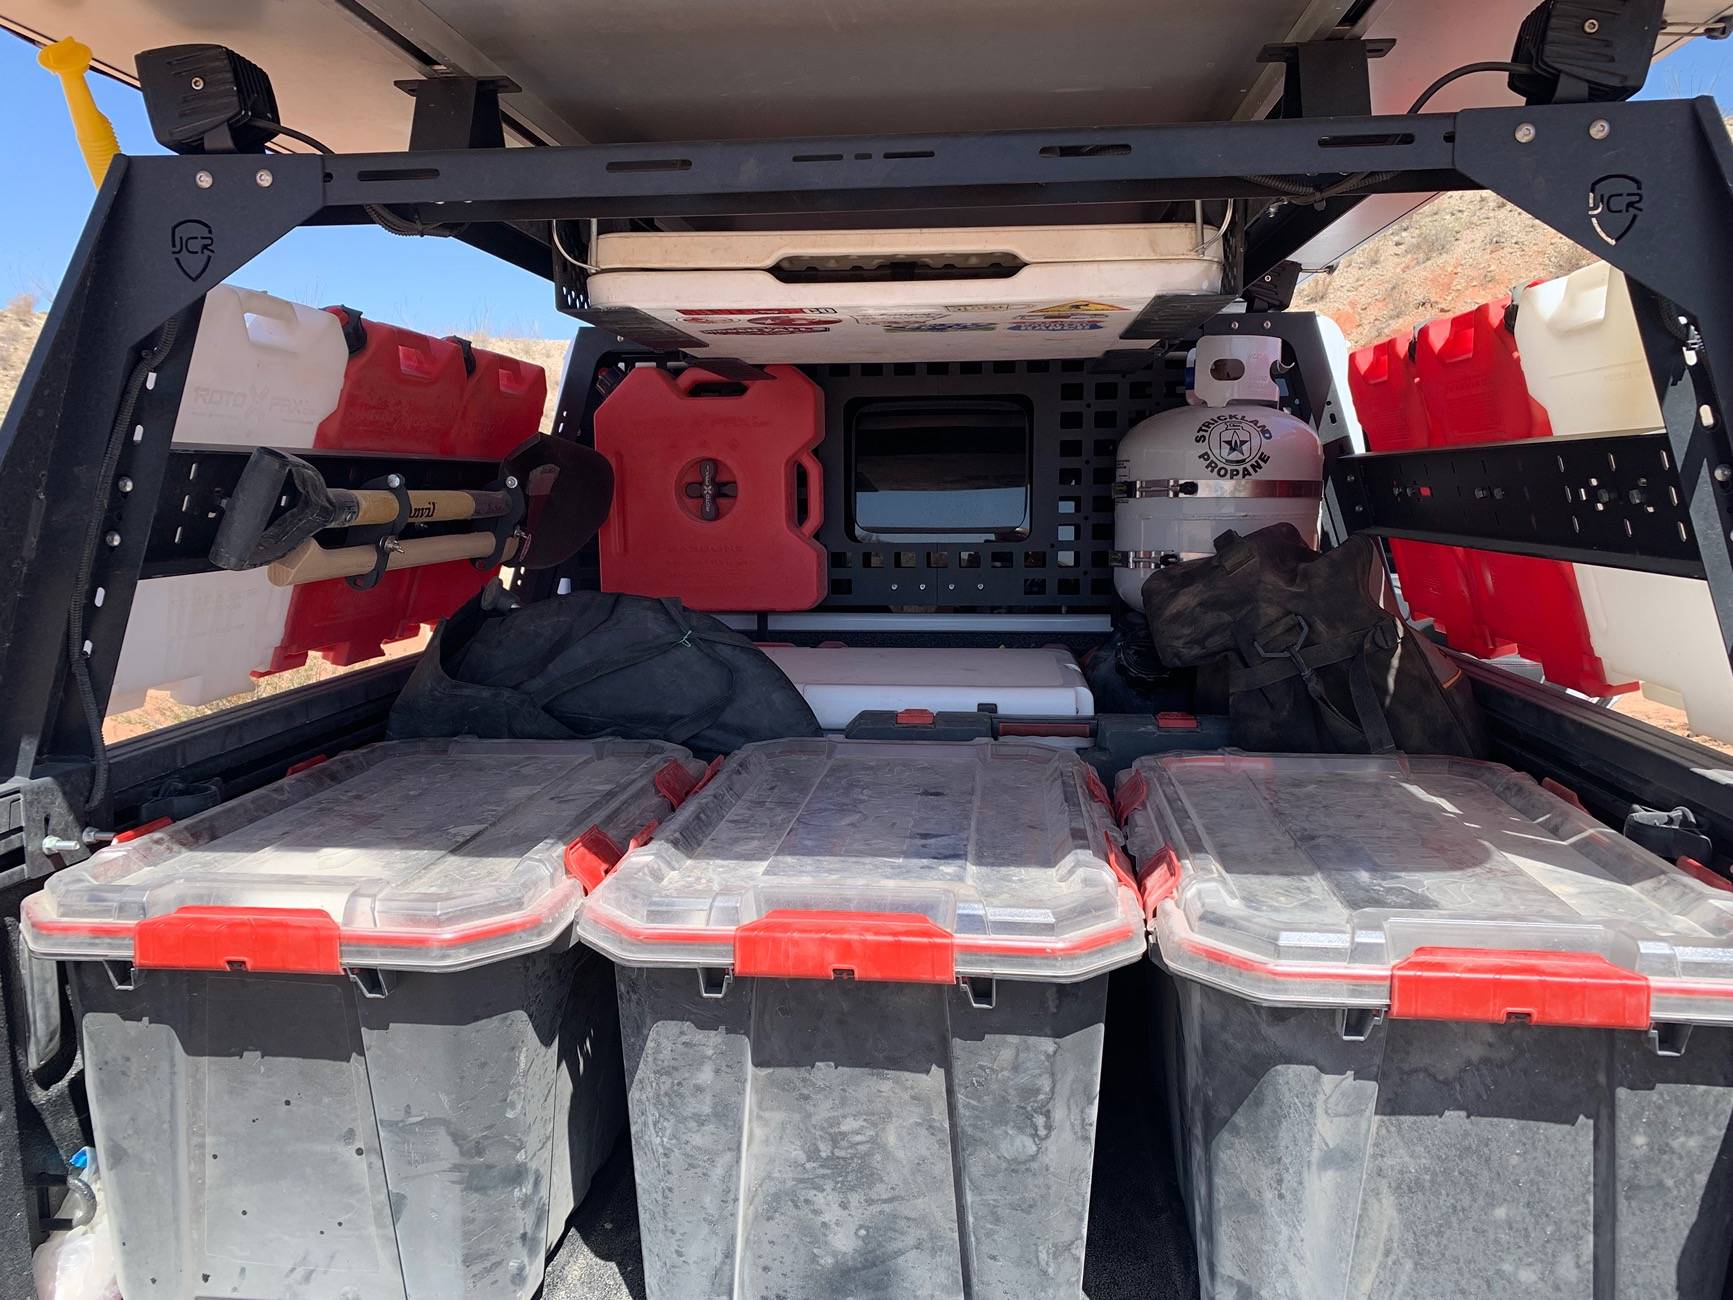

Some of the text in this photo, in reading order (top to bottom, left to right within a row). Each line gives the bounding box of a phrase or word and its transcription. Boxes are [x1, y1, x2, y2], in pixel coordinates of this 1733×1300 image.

[1588, 192, 1643, 214] JCR
[171, 235, 215, 254] JCR
[1194, 414, 1273, 443] STRICKLAND
[1198, 451, 1271, 479] PROPANE
